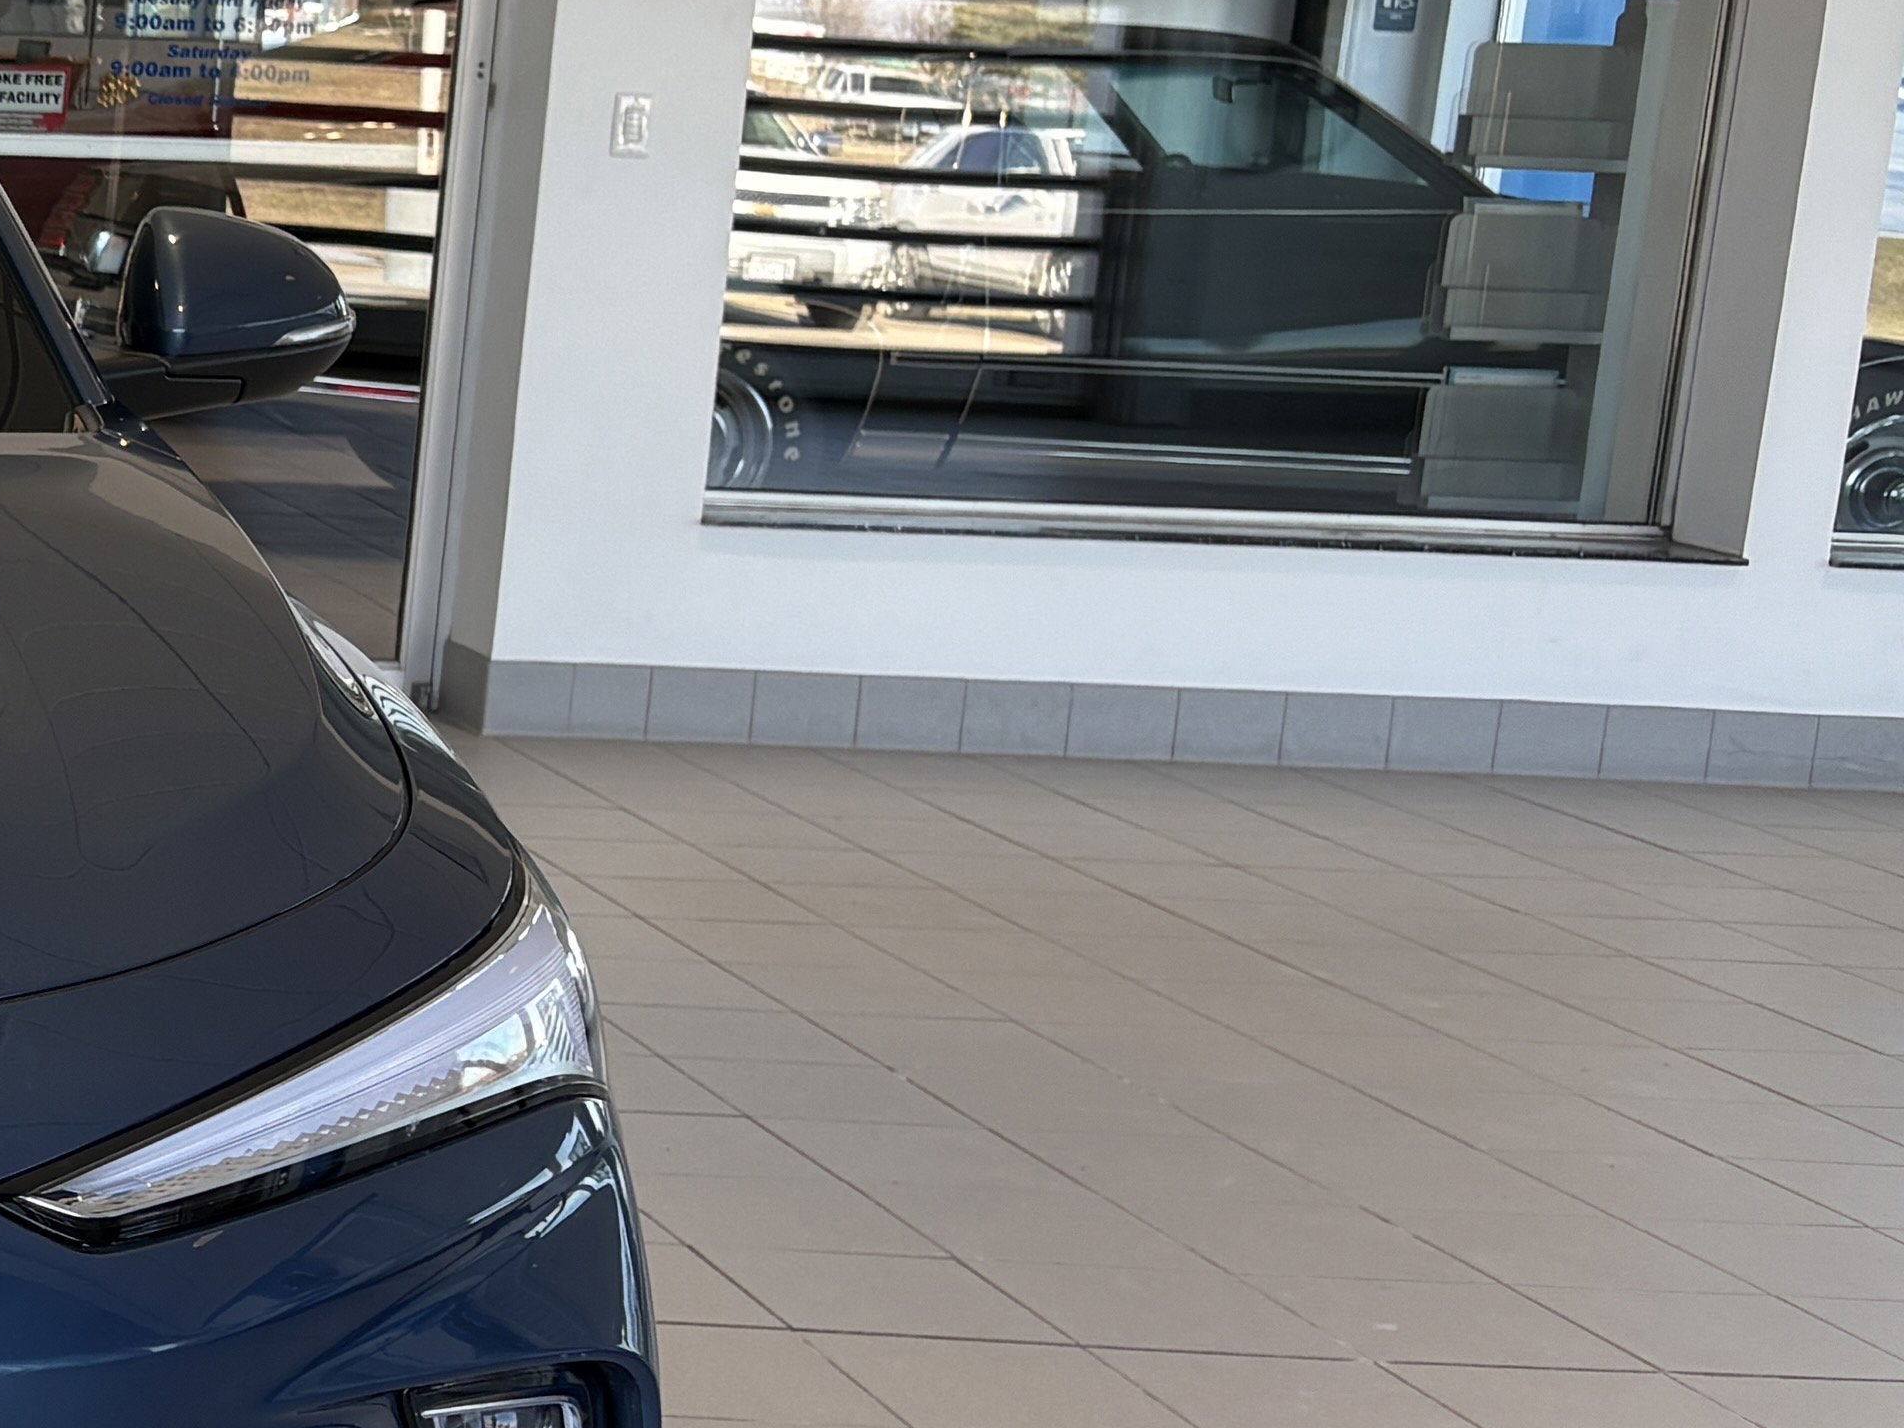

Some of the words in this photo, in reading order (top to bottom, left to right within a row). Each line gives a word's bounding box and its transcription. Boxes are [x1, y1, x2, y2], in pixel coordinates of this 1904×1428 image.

[114, 13, 196, 32] 9:00am
[204, 15, 226, 33] to
[234, 18, 315, 38] 6:0pm
[167, 44, 252, 62] Saturday
[110, 61, 192, 80] 9:00am
[199, 62, 222, 80] to
[25, 74, 63, 87] FREE
